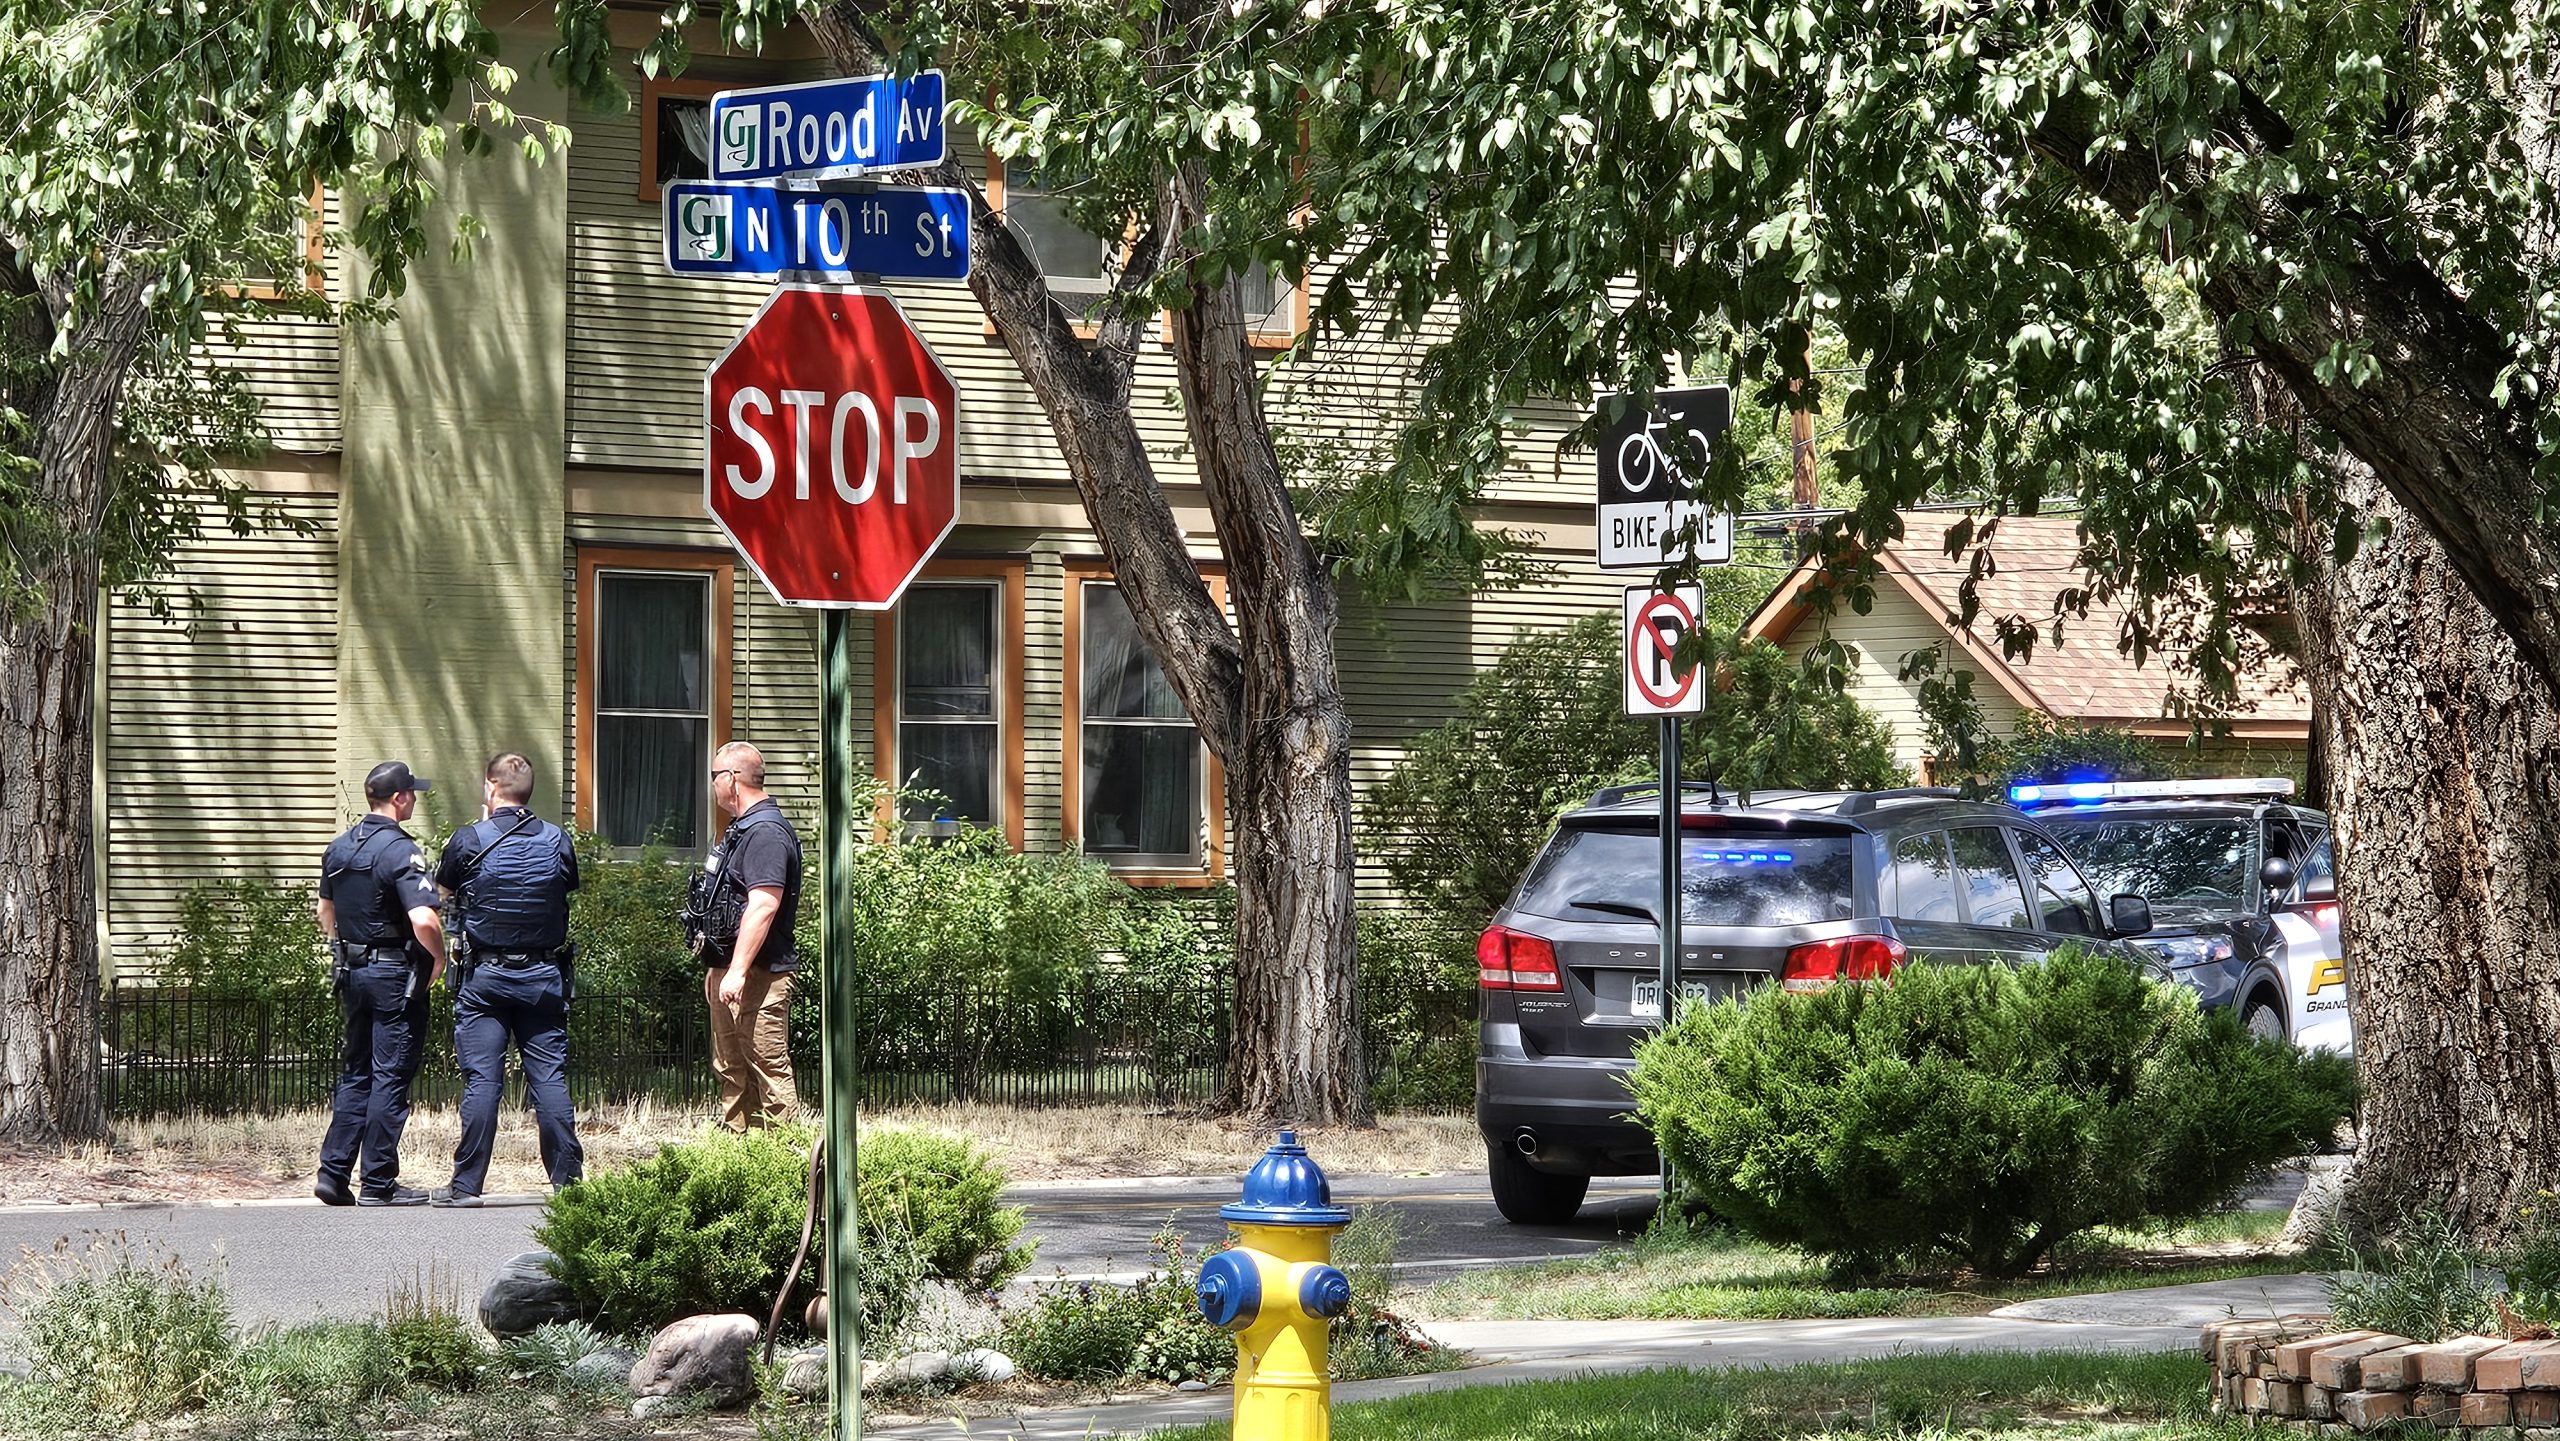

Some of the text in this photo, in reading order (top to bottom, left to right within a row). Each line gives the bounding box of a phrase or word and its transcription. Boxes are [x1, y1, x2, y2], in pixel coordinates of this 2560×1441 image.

[768, 91, 933, 168] Rood Av
[747, 206, 769, 253] N
[915, 212, 953, 259] St
[725, 386, 941, 505] STOP
[1613, 516, 1657, 549] BIKE
